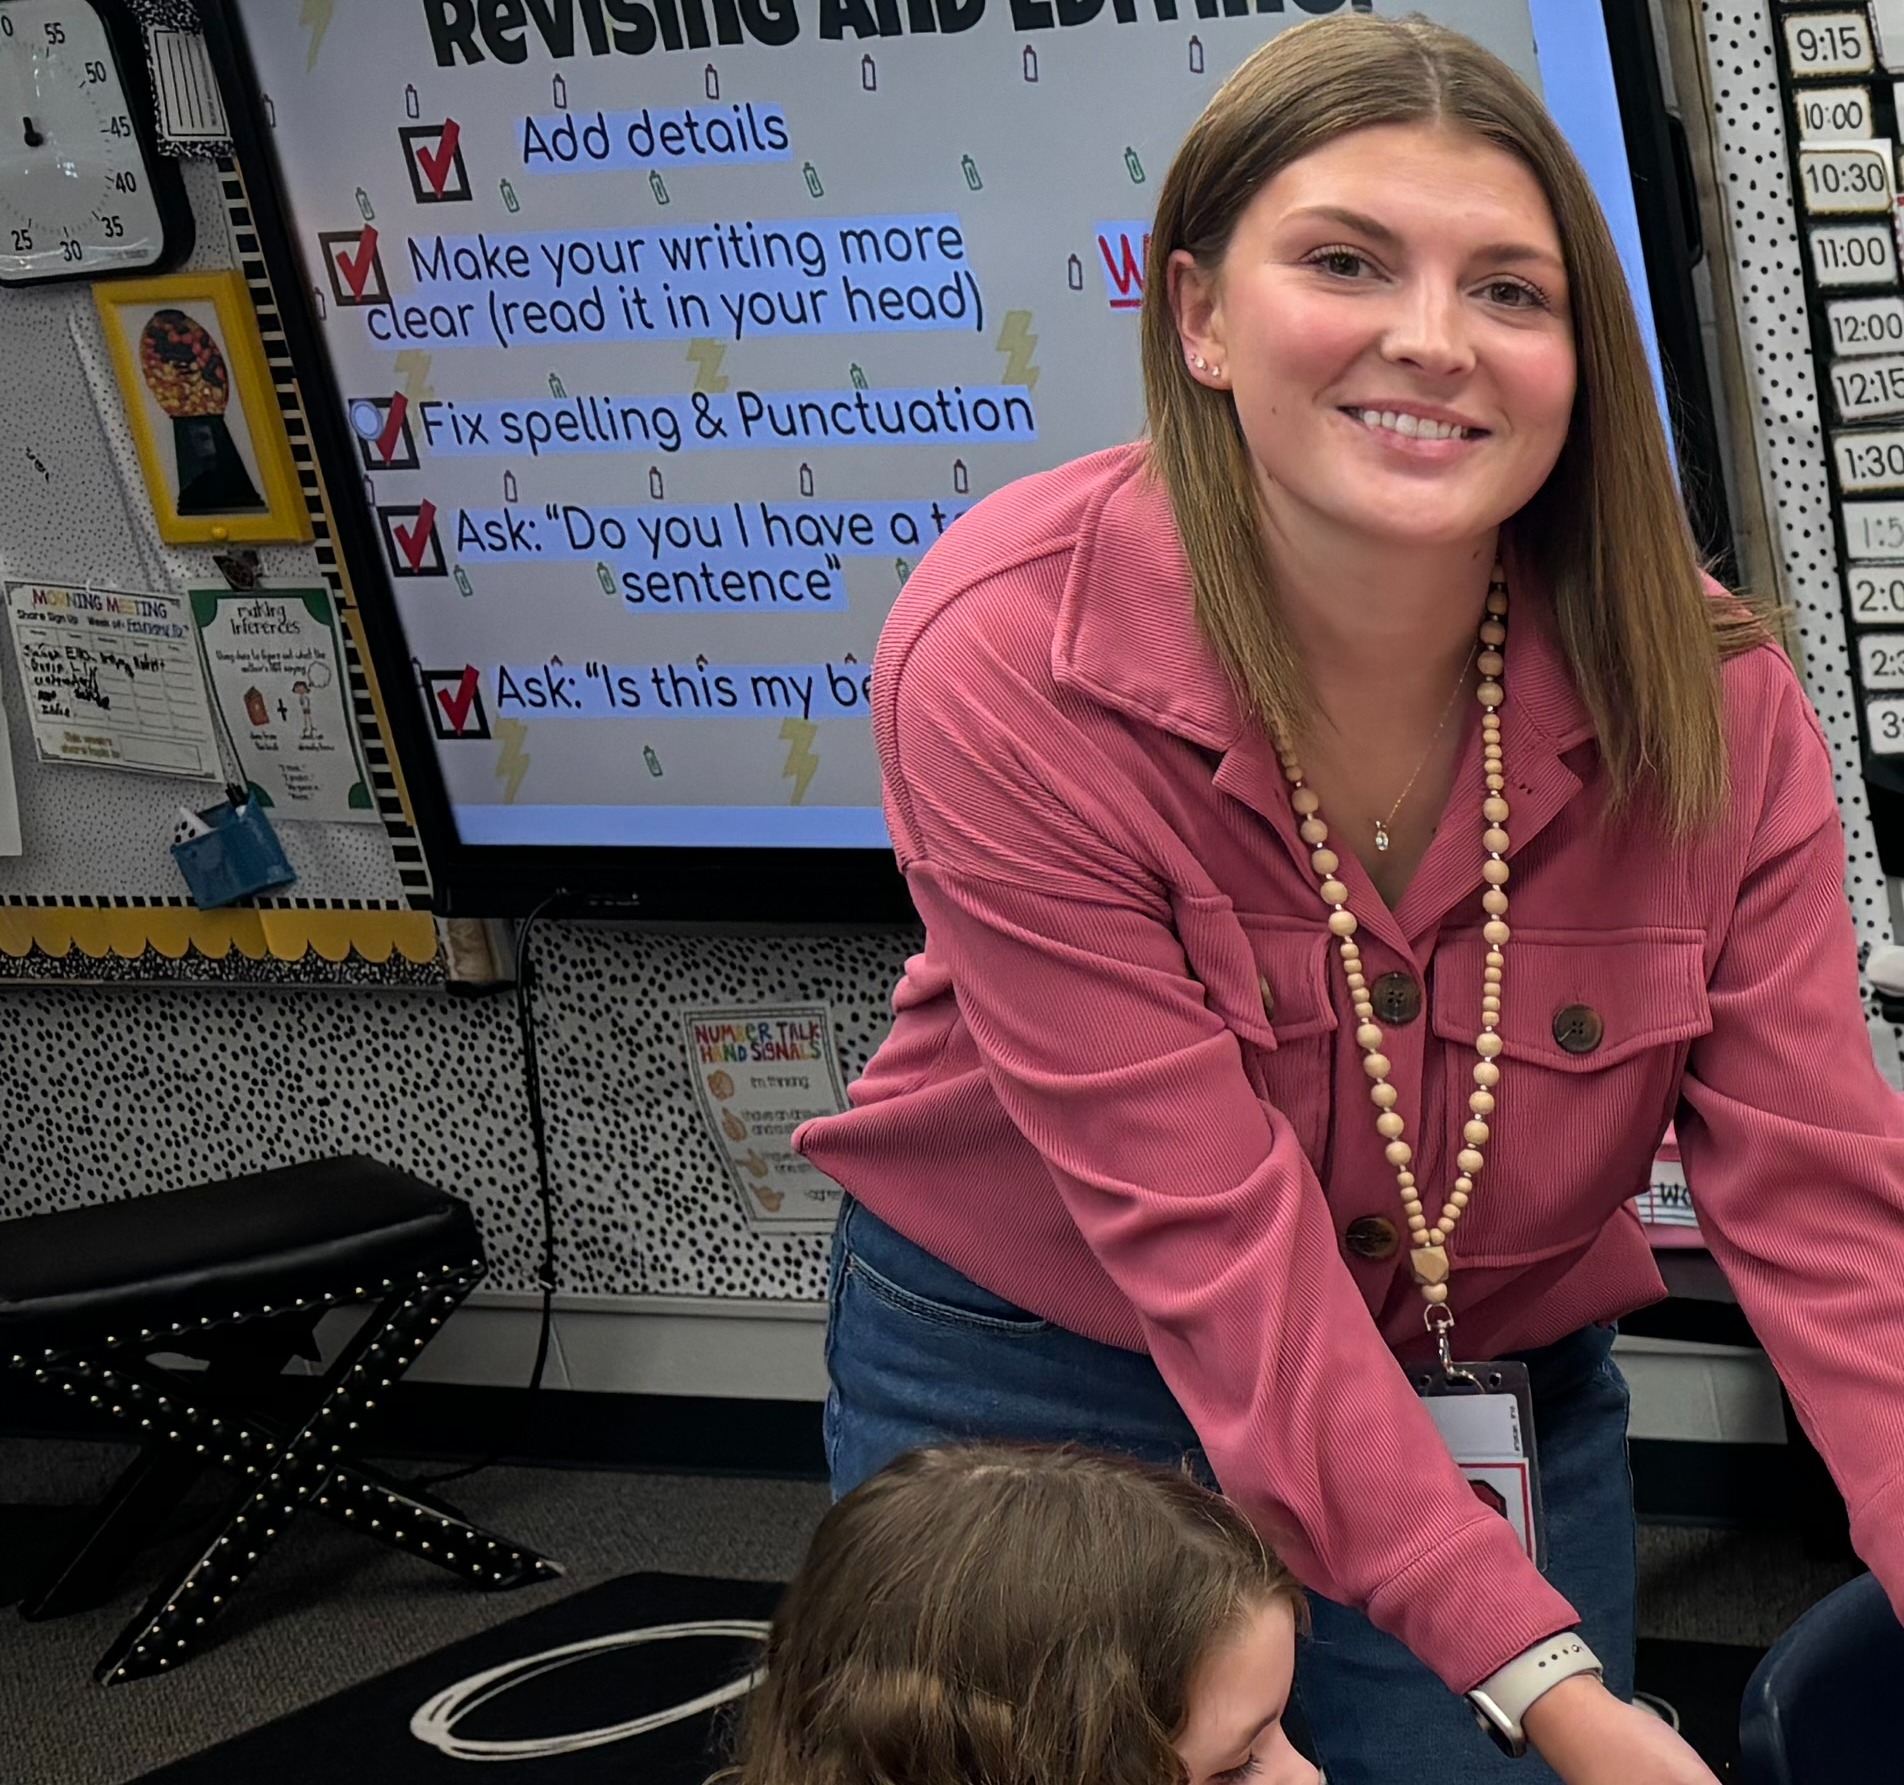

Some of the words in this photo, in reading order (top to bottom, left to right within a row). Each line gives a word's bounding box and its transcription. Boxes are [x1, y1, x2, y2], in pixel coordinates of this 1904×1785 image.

[44, 22, 65, 45] 55
[1796, 27, 1862, 62] 9:15
[84, 60, 107, 84] 50
[110, 115, 131, 138] 45
[1803, 101, 1863, 130] 10:00
[522, 112, 610, 165] Add
[627, 104, 790, 158] details
[114, 171, 137, 194] 40
[1806, 161, 1885, 194] 10:30
[11, 229, 33, 251] 25
[101, 215, 124, 238] 35
[60, 239, 83, 262] 30
[408, 235, 531, 283] Make
[540, 238, 646, 287] your
[660, 226, 826, 276] writing
[841, 221, 965, 262] more
[1817, 236, 1886, 268] 11:00
[367, 299, 473, 343] clear
[490, 287, 605, 348] (read
[619, 285, 655, 329] it
[664, 284, 710, 328] in
[724, 283, 832, 339] your
[842, 273, 984, 331] head)
[1833, 312, 1903, 342] 12:00
[424, 401, 488, 447] Fix
[498, 399, 682, 453] spelling
[693, 397, 730, 442] &
[740, 387, 1033, 438] Punctuation
[457, 508, 540, 554] Ask:
[647, 515, 722, 563] you
[761, 500, 873, 548] have
[891, 515, 920, 547] a
[32, 589, 102, 611] MORNING
[106, 596, 167, 618] MEETING
[496, 664, 583, 710] Ask:
[652, 660, 740, 706] this
[752, 672, 813, 719] my
[776, 1021, 821, 1043] TALK
[701, 1046, 747, 1063] HAND
